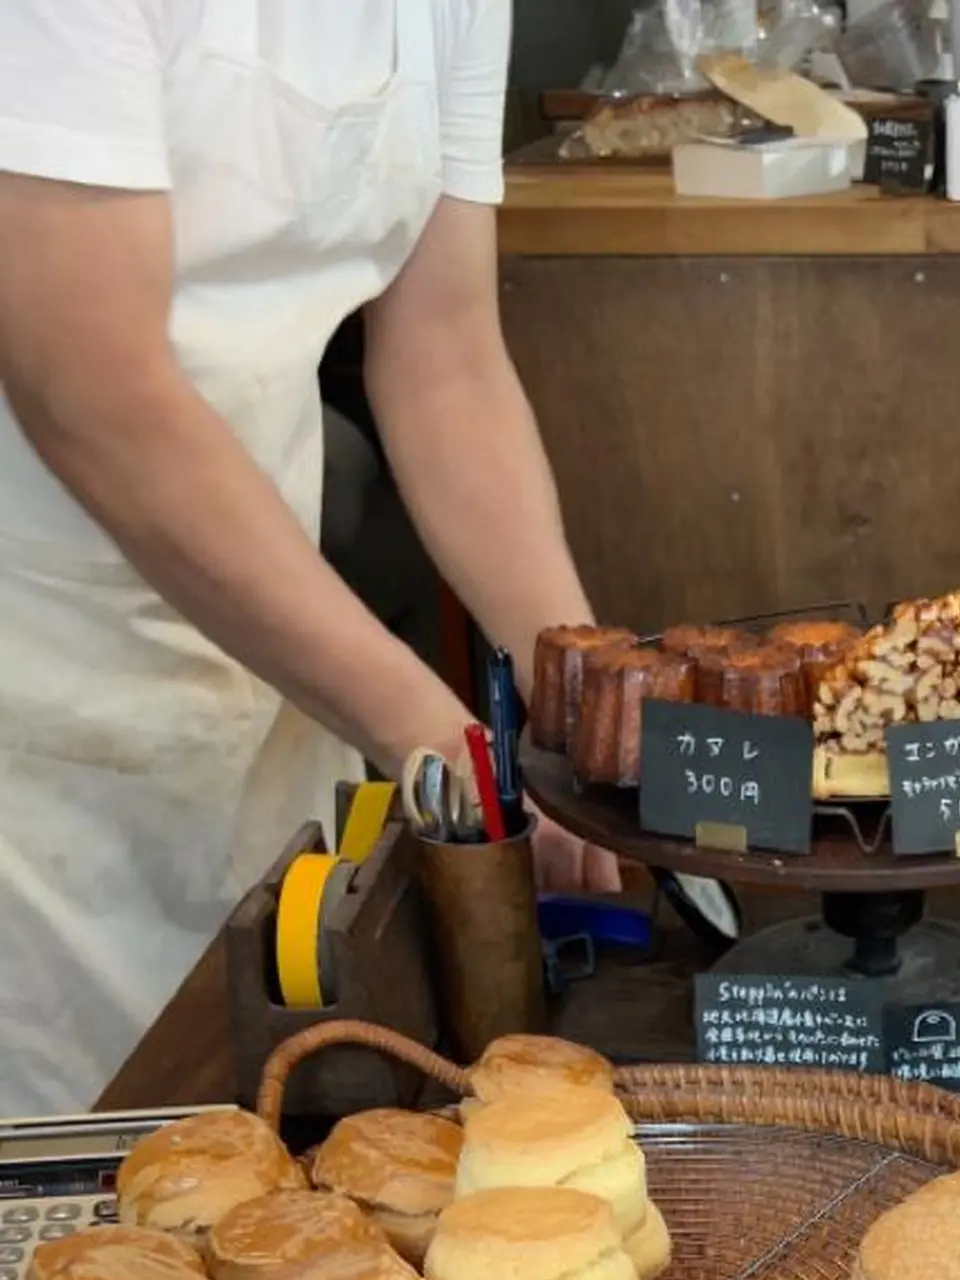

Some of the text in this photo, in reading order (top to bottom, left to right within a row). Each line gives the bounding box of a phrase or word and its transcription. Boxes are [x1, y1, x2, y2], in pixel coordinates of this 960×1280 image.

[677, 731, 759, 759] カヌレ
[684, 767, 760, 806] 300円
